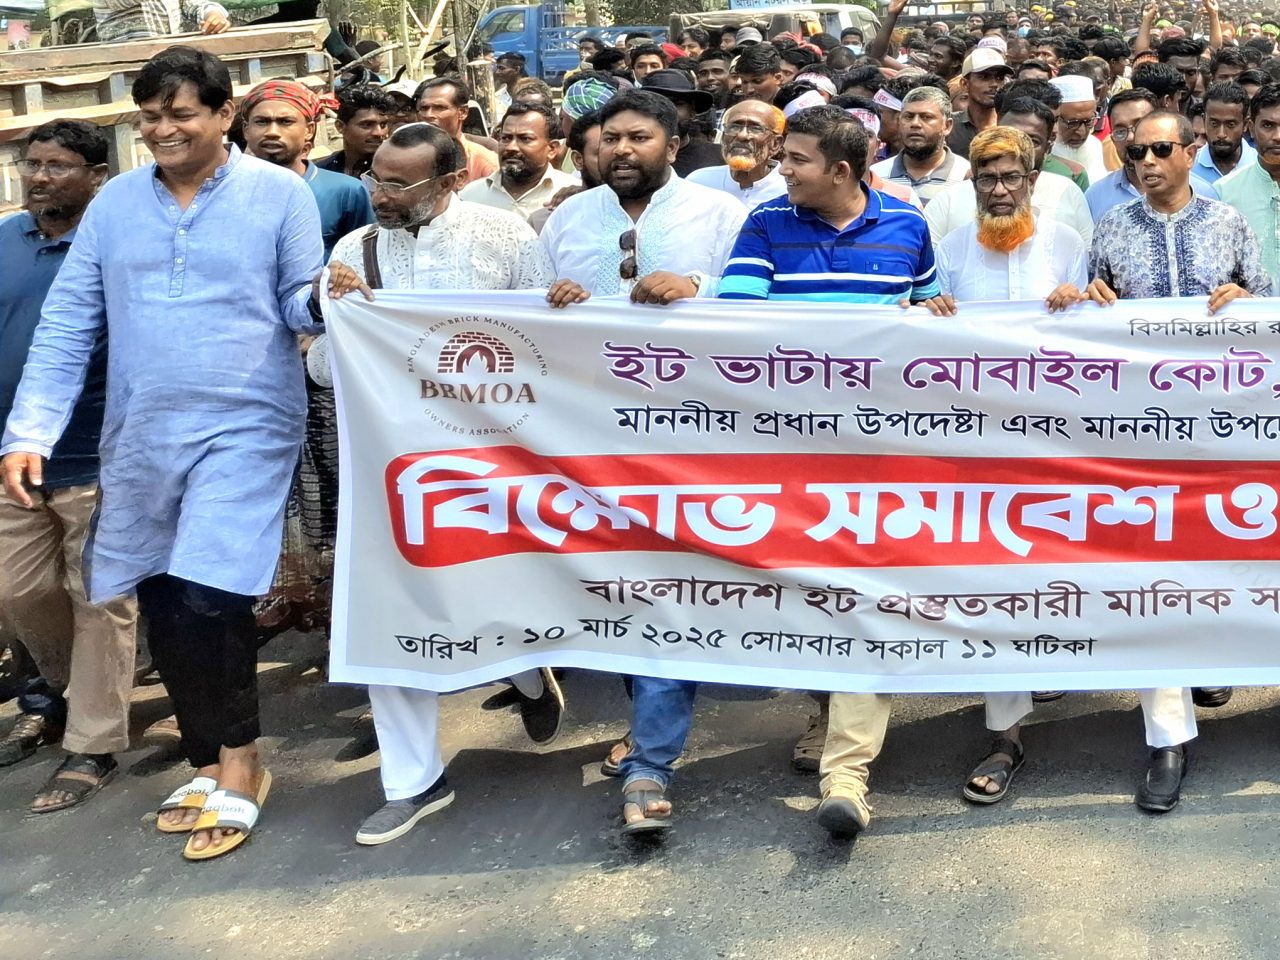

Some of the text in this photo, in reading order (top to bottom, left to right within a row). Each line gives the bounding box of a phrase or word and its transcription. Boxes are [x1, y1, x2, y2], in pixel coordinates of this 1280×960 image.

[1127, 318, 1257, 337] বিসমিল্লাহির
[602, 341, 695, 391] ইট
[708, 344, 885, 391] ভাটায়
[902, 345, 1130, 396] মোবাইল
[419, 378, 537, 405] BRMOA
[424, 408, 465, 435] OWNERS
[611, 399, 742, 436] মাননীয়
[752, 408, 845, 438] প্রধান
[852, 404, 991, 438] উপদেষ্টা
[1001, 413, 1071, 440] এবং
[1082, 407, 1199, 442] মাননীয়
[396, 454, 783, 548] বিক্ষোভ
[803, 482, 1180, 558] সমাবেশ
[1204, 482, 1279, 540] ও
[579, 575, 787, 611] বাংলাদেশ
[876, 580, 1090, 621] প্রস্তুতকারী
[1102, 579, 1236, 618] মালিক
[394, 633, 483, 660] তারিখ
[522, 626, 566, 645] ১০
[577, 614, 634, 639] মার্চ
[641, 623, 728, 650] ২০২৫
[740, 630, 857, 657] সোমবার
[862, 638, 949, 661] সকাল
[961, 638, 997, 659] ১১
[1010, 634, 1098, 658] ঘটিকা
